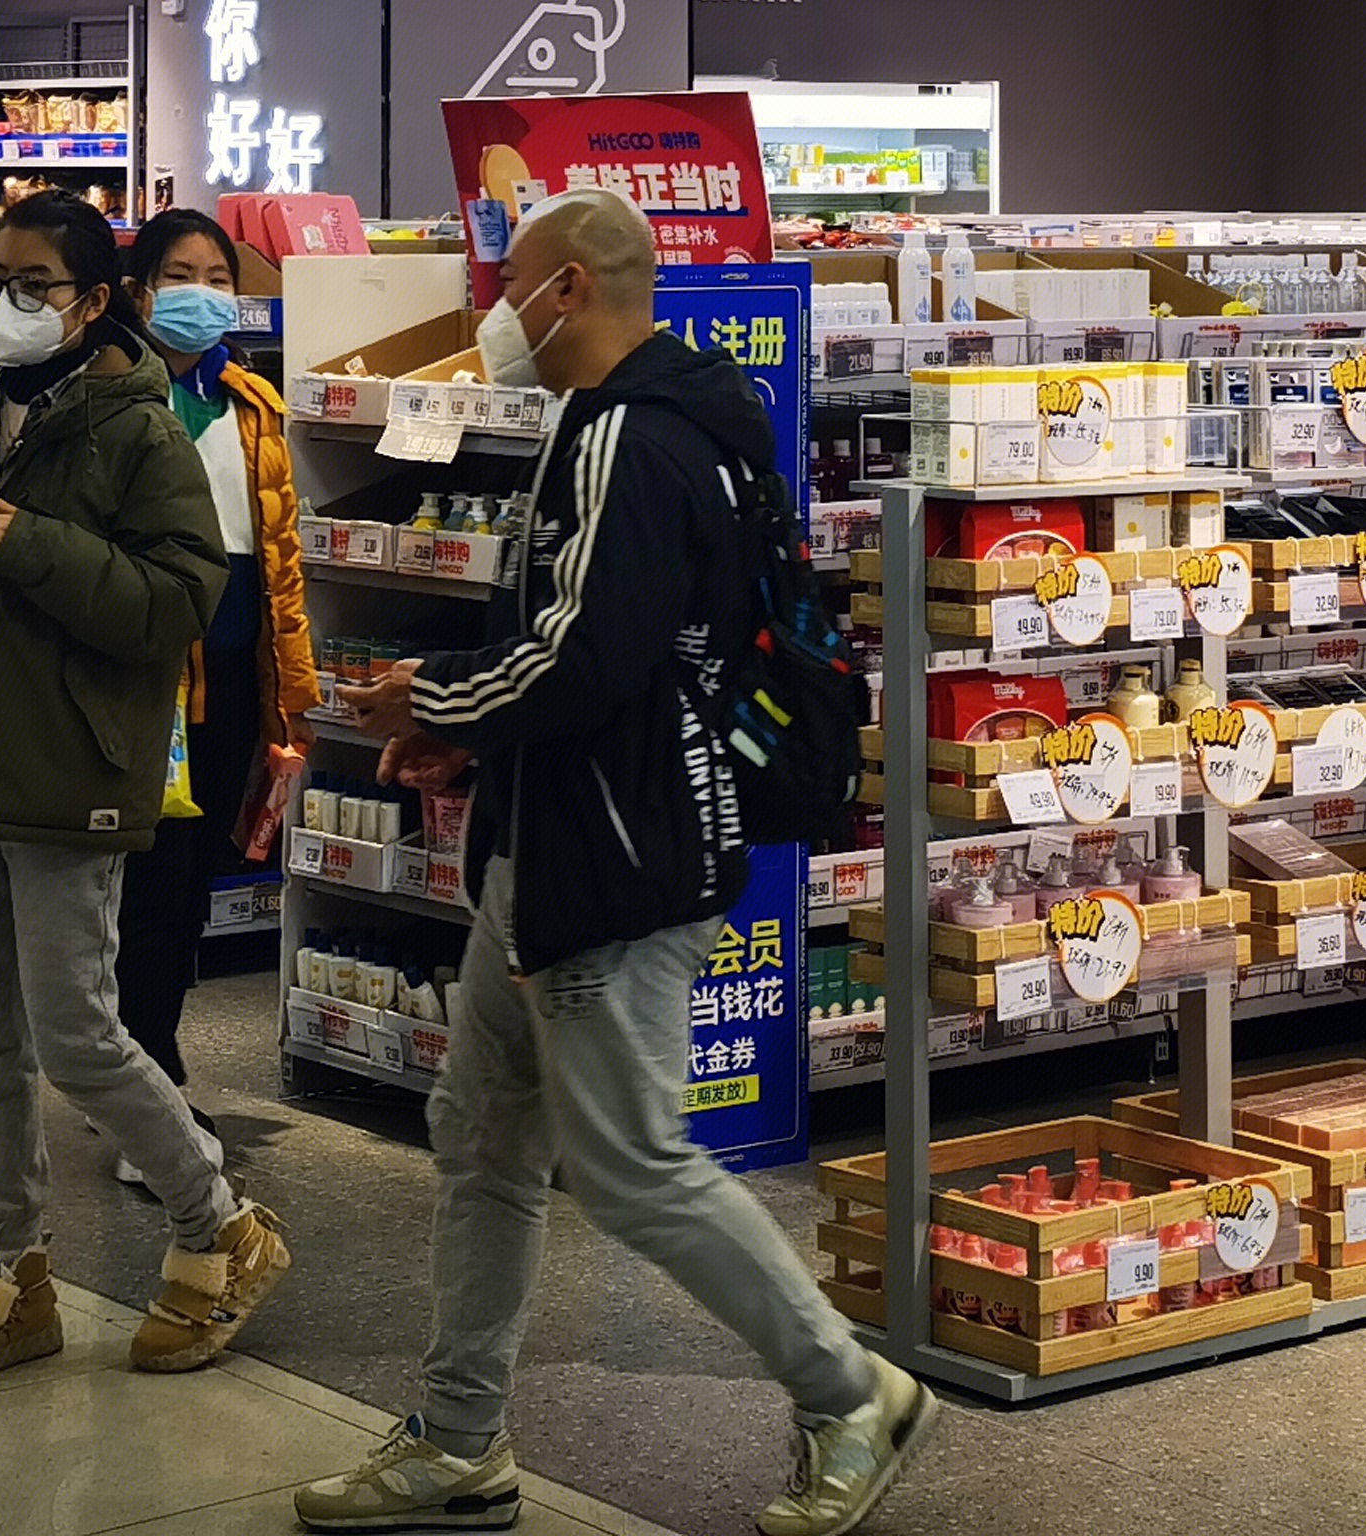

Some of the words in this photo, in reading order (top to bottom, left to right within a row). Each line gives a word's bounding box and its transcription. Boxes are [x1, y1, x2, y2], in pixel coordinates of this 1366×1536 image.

[588, 132, 654, 151] HitGOO
[241, 310, 269, 326] 24.60
[1291, 424, 1315, 440] 32.90
[1007, 441, 1034, 458] 79.00
[1315, 594, 1338, 612] 32.90
[1017, 616, 1043, 636] 49.90
[1155, 609, 1177, 627] 79.00
[1319, 764, 1343, 782] 32.90
[1155, 784, 1177, 802] 19.90
[1021, 980, 1047, 1000] 29.90
[691, 976, 784, 1027] 当钱花
[829, 1044, 853, 1060] 33.90
[1134, 1265, 1154, 1282] 9.90
